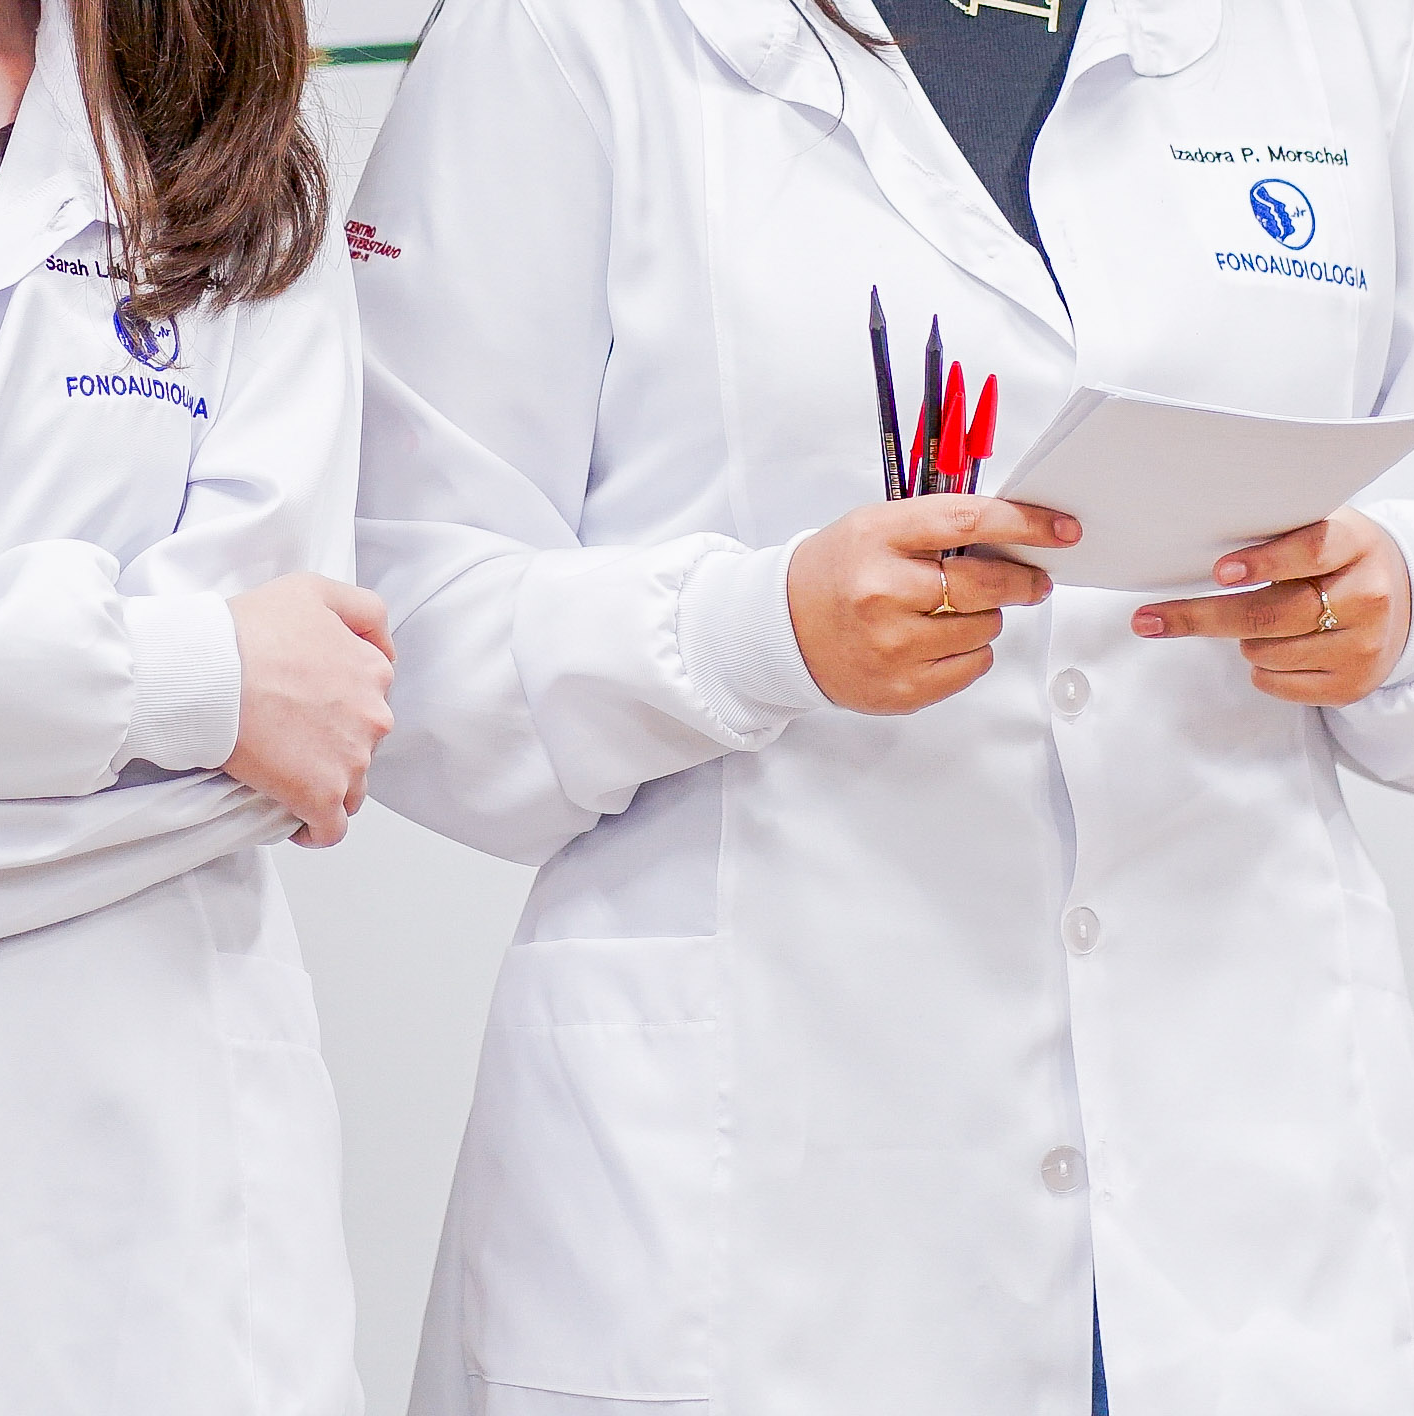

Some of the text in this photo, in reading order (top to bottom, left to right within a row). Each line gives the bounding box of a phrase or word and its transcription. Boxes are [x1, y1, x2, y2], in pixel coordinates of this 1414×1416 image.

[1170, 144, 1349, 167] Izadora P. Morschel
[46, 255, 89, 277] Sarah
[1215, 252, 1368, 291] FONOAUDIOLOGIA
[67, 375, 208, 419] FONOAUDIOLA
